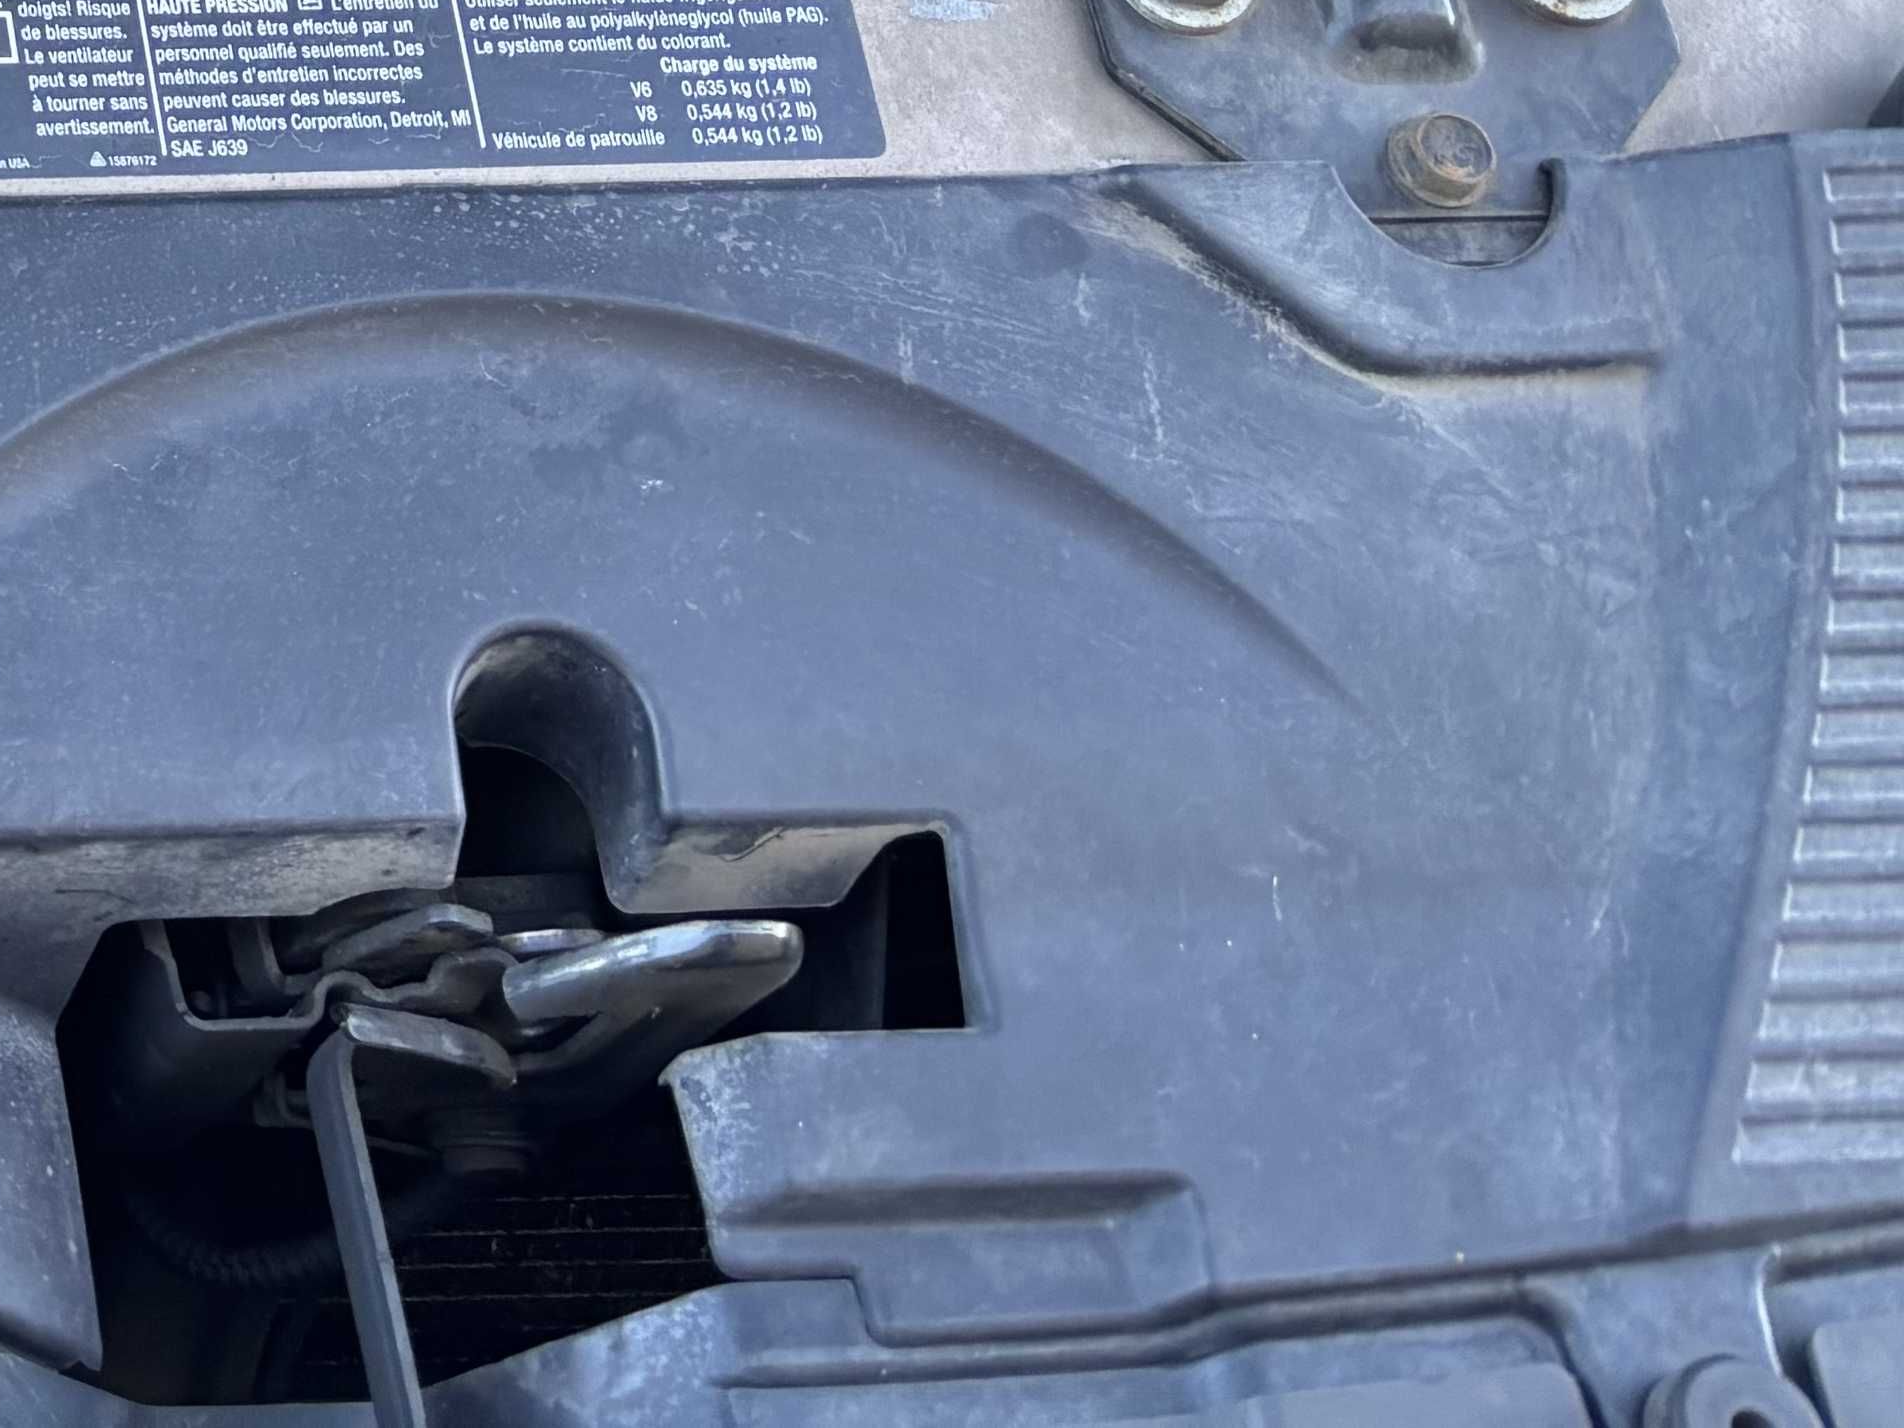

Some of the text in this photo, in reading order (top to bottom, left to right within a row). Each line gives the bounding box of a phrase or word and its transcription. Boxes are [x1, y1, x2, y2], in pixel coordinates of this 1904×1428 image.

[18, 0, 130, 20] doigts! Risque
[470, 7, 828, 31] et de l'huile au polyalkylèneglycol (huile PAG).
[21, 24, 127, 40] de blessures.
[151, 17, 413, 41] système doit être effectué par un
[24, 47, 133, 64] Le ventilateur
[155, 40, 424, 65] personnel qualifié seulement. Des
[473, 33, 730, 57] Le système contient du colorant.
[159, 64, 423, 85] méthodes d'entretien incorrectes
[660, 54, 817, 75] Charge du système
[29, 71, 144, 91] peut se mettre
[630, 78, 811, 98] V6 0,635 kg (1,4 lb)
[33, 94, 148, 112] à tourner sans
[163, 89, 405, 112] peuvent causer des blessures.
[167, 110, 471, 133] General Motors Corporation, Detroit, MI
[635, 101, 816, 122] V8 0,544 kg (1,2 lb)
[36, 118, 154, 136] avertissement.
[492, 125, 823, 150] Véhicule de patrouille 0,544 kg (1,2 lb)
[171, 139, 248, 157] SAE J639
[8, 158, 30, 168] USA
